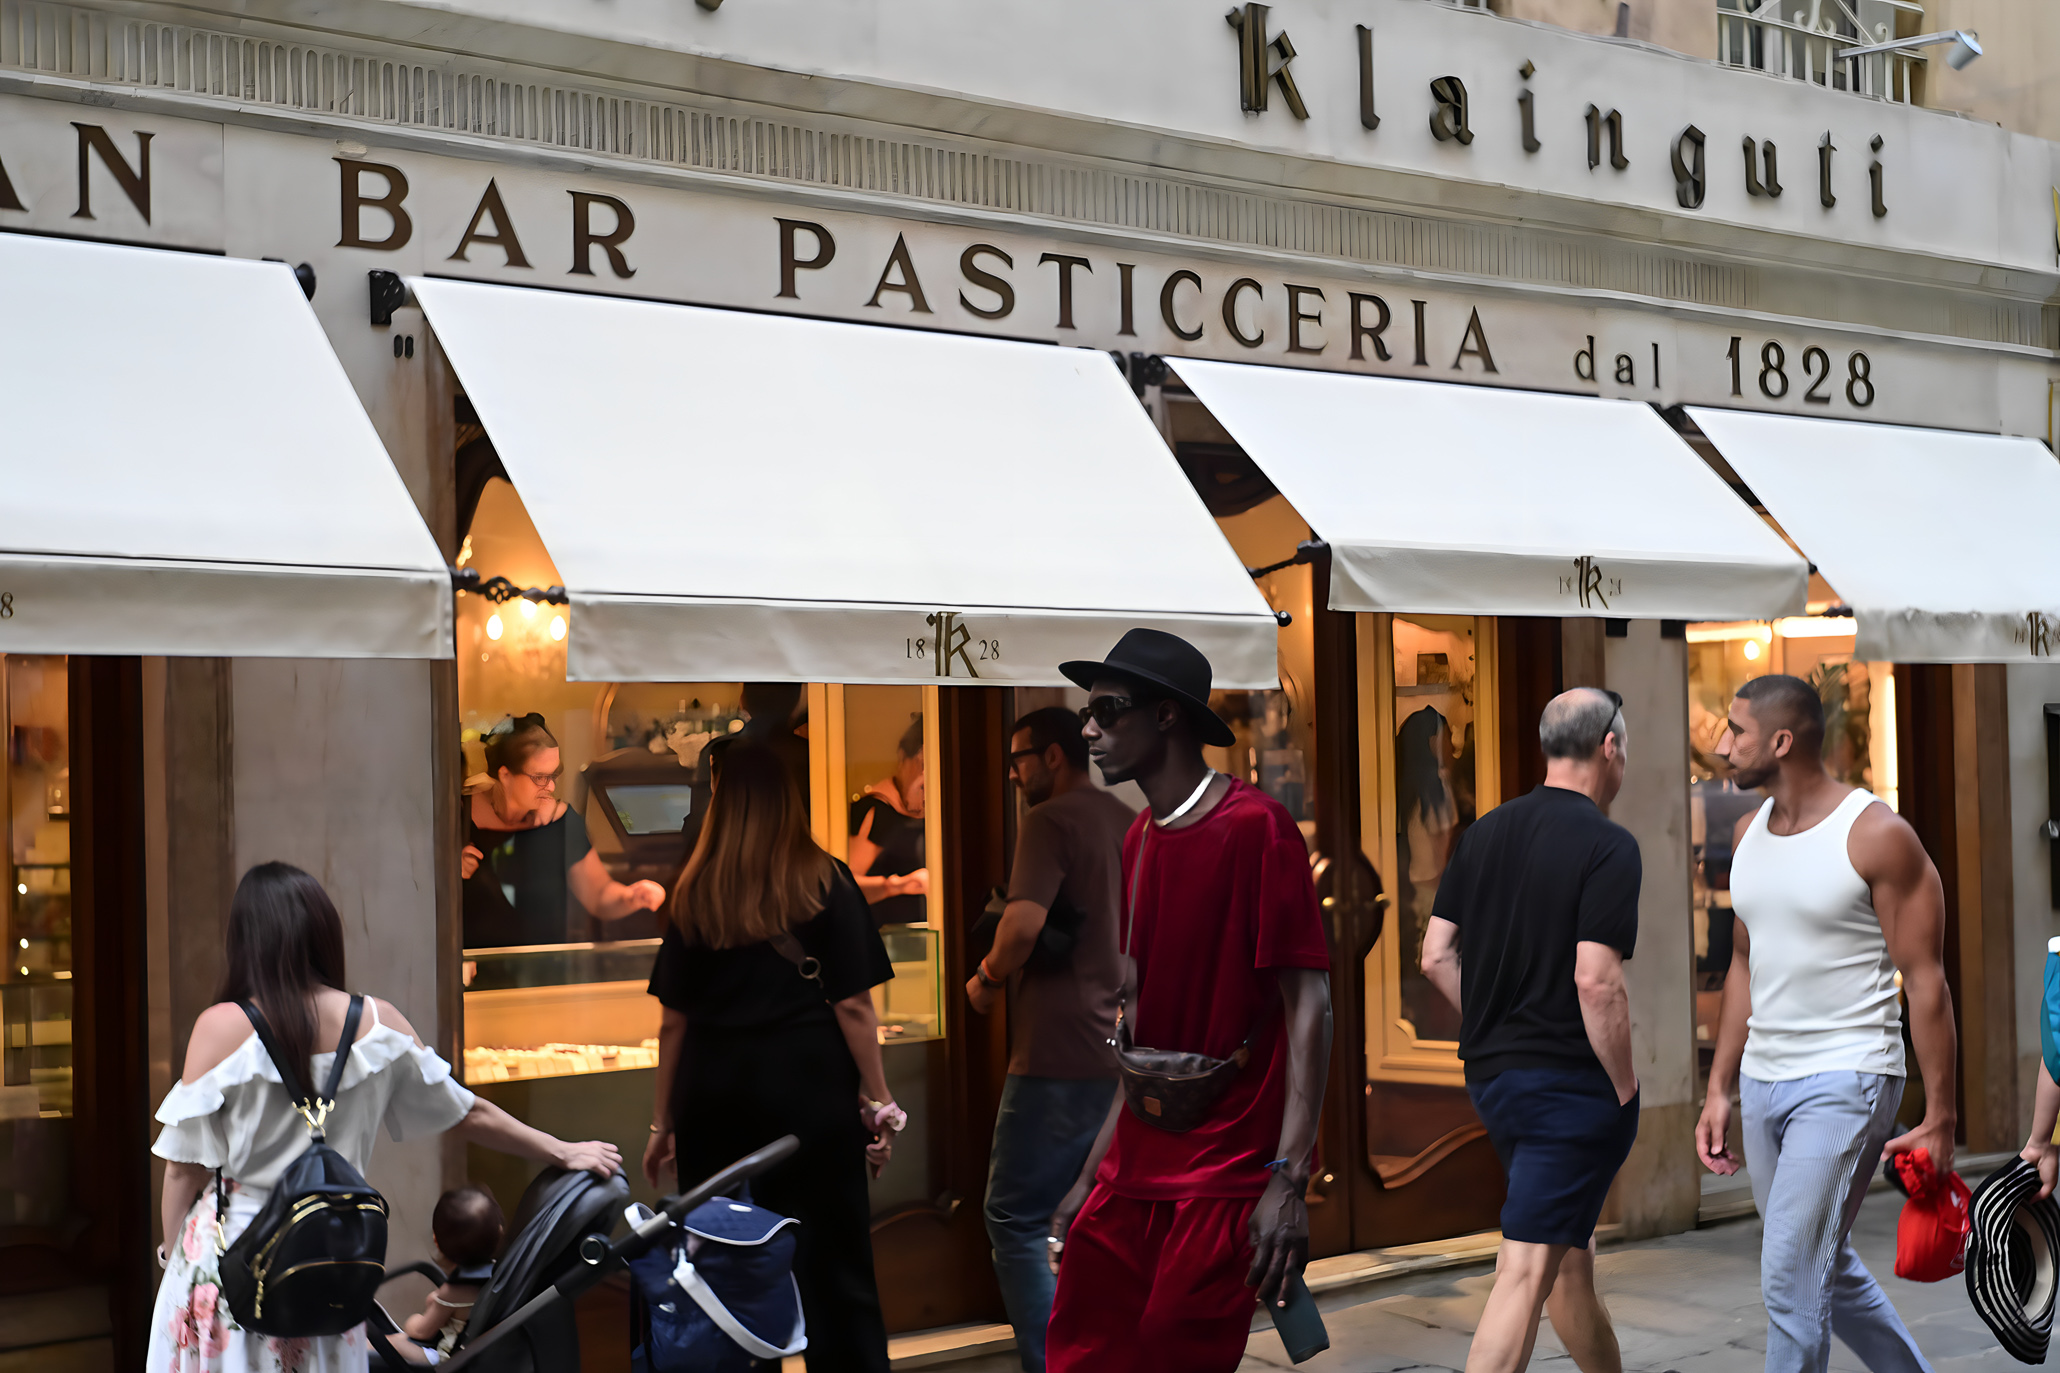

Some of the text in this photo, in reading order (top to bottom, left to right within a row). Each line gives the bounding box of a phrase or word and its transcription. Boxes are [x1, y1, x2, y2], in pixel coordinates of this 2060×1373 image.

[331, 156, 637, 279] BAR
[773, 217, 1499, 374] PASTICCERIA
[1573, 335, 1660, 389] dal
[1725, 336, 1876, 408] 1828
[906, 637, 926, 660] 18
[978, 639, 1000, 661] 28
